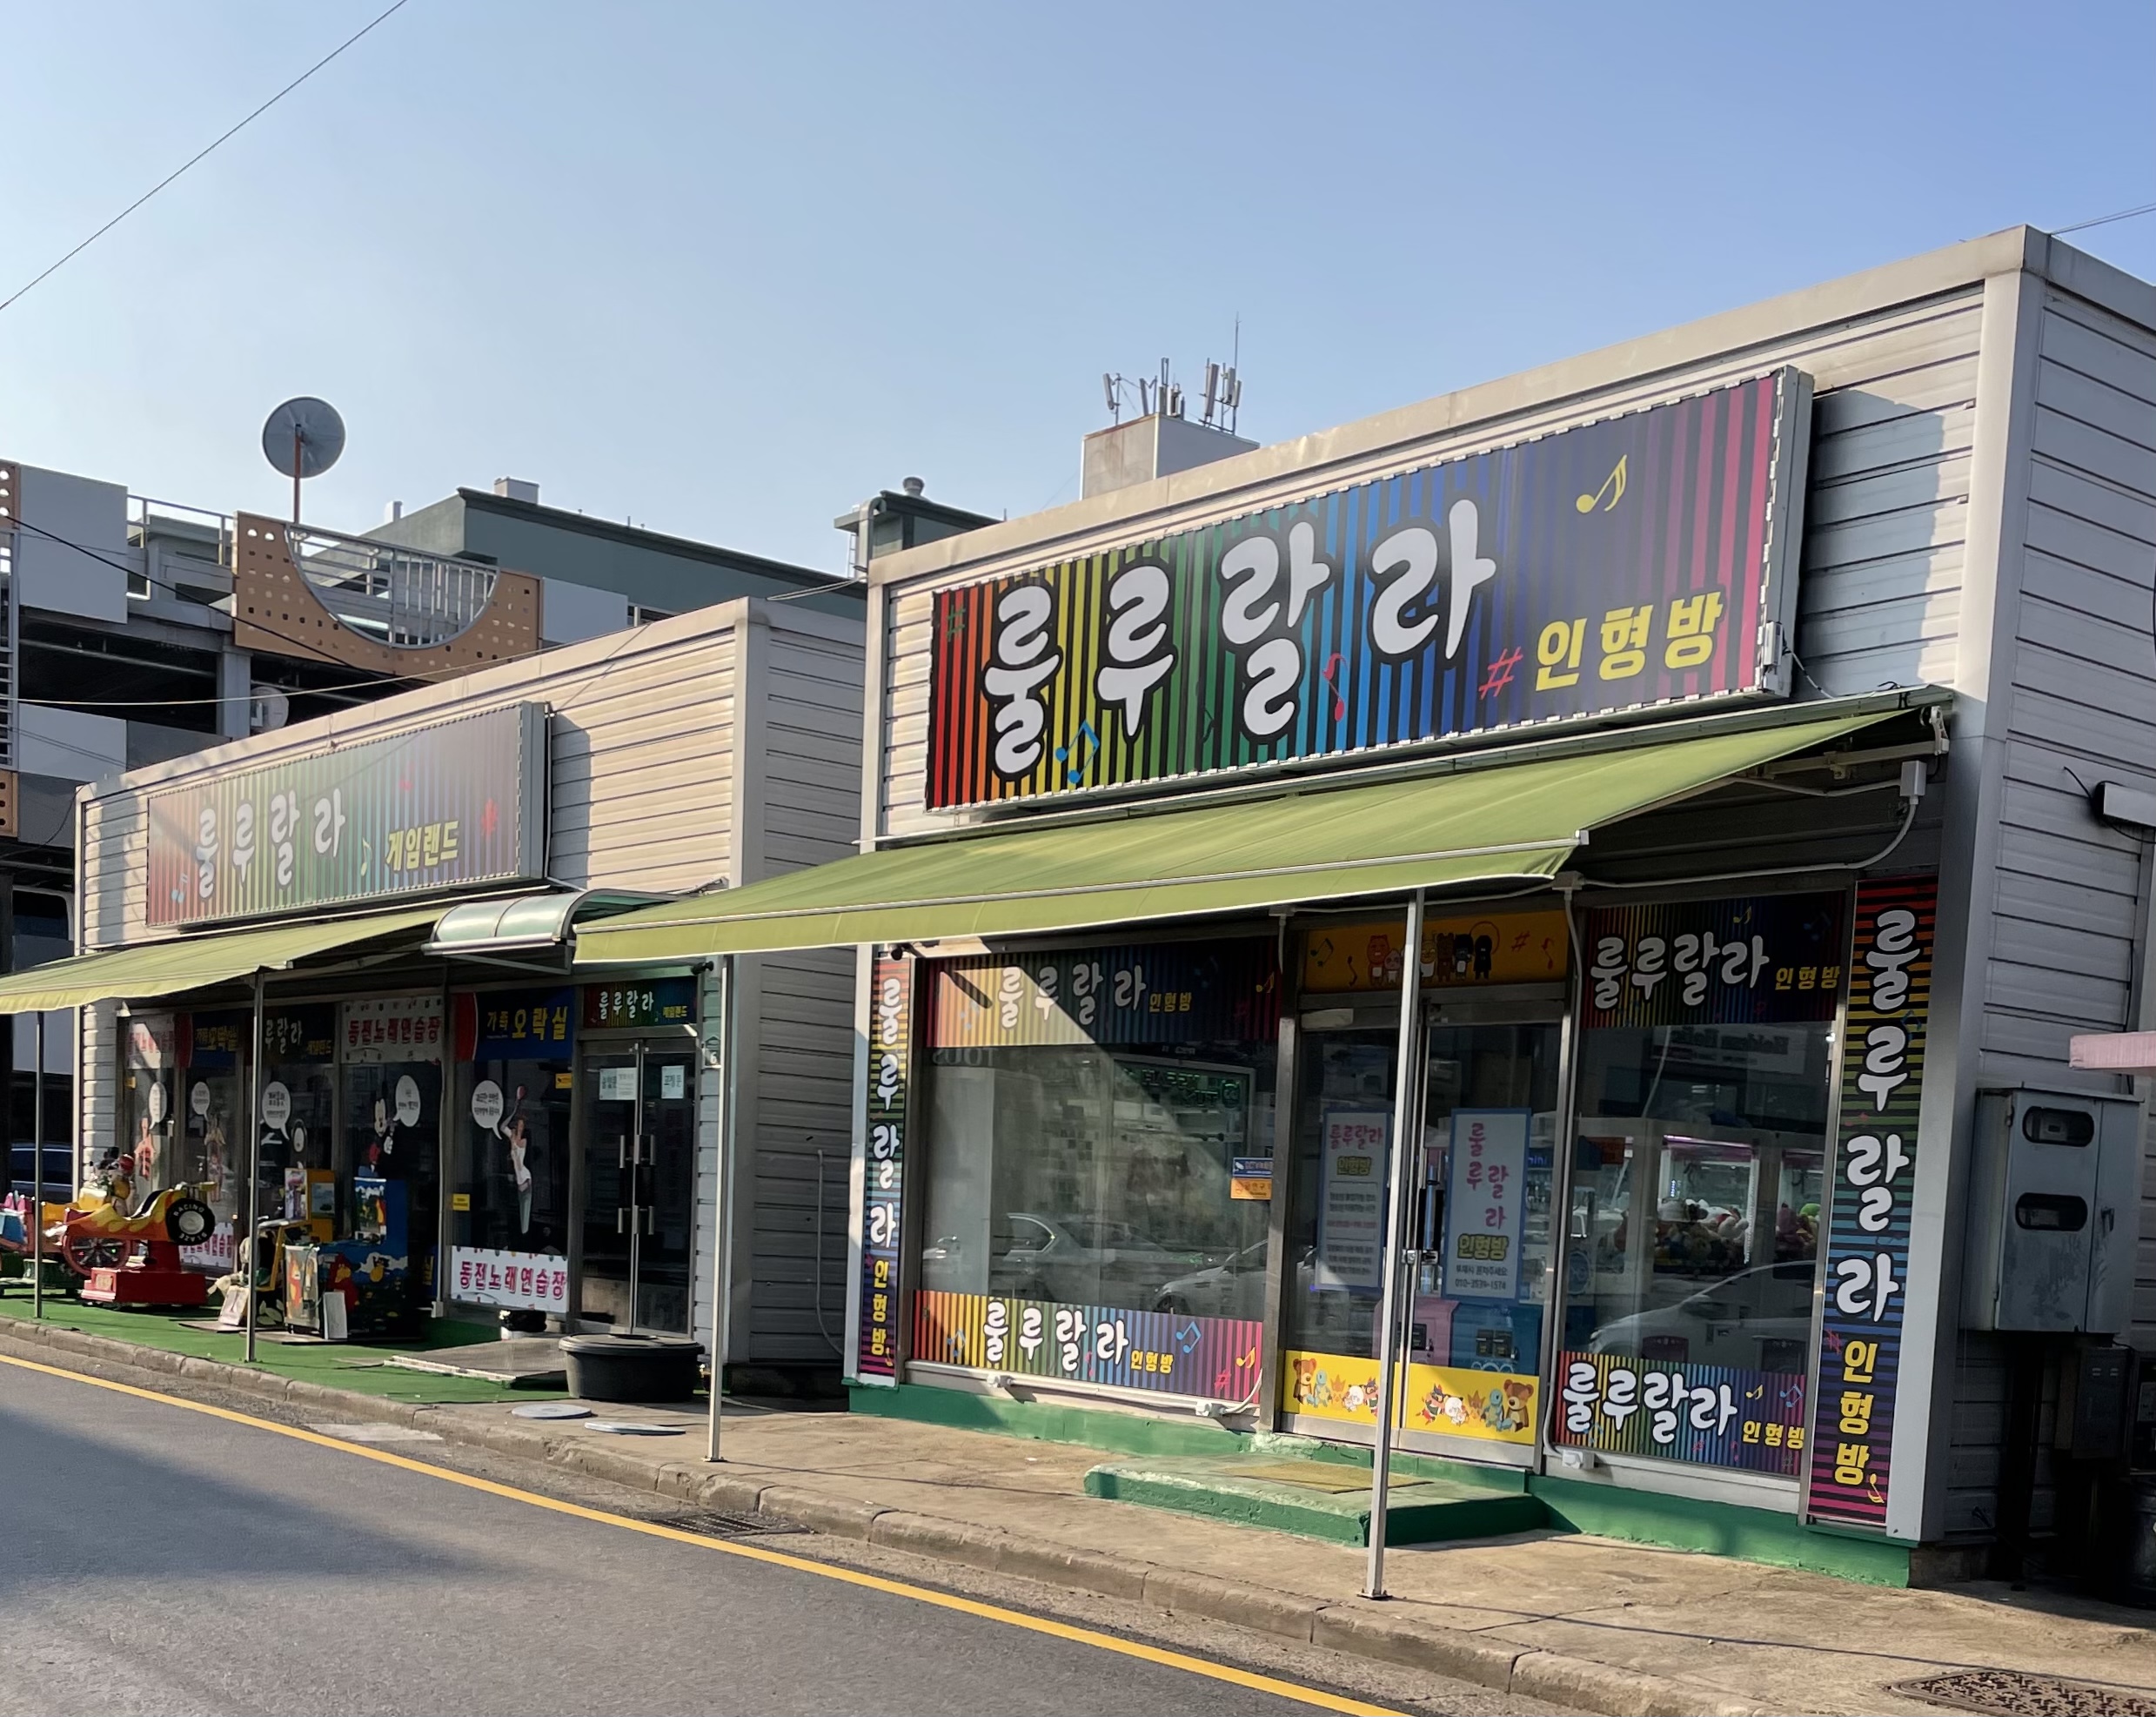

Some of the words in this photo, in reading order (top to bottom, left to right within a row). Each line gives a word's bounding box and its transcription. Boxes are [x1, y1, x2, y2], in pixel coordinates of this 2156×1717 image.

[984, 499, 1496, 774] 룰루랄라
[1533, 592, 1724, 692] 인형방
[197, 788, 345, 899] 룰루랄라
[385, 820, 460, 871] 게임랜드
[599, 990, 654, 1020] 룰루랄라
[997, 962, 1147, 1029] 룰루랄라
[1148, 992, 1192, 1013] 인형방
[1590, 931, 1769, 1009] 룰루랄라
[1775, 966, 1840, 989] 인형방
[264, 1017, 303, 1055] 루랄라
[348, 1016, 441, 1046] 동전노래연습장
[512, 1006, 568, 1041] 오락실
[869, 977, 902, 1248] 룰루랄라
[1329, 1124, 1383, 1150] 룰루랄라
[1836, 909, 1918, 1321] 룰루랄라
[173, 1204, 204, 1217] RACING
[459, 1261, 568, 1300] 동전노래연습장
[1456, 1233, 1509, 1261] 인형방
[871, 1260, 889, 1357] 인형방
[984, 1300, 1129, 1371] 룰루랄라
[1130, 1350, 1174, 1374] 인형방
[1563, 1361, 1738, 1443] 룰루랄라
[1743, 1420, 1804, 1449] 인형방
[1834, 1339, 1879, 1486] 인형방
